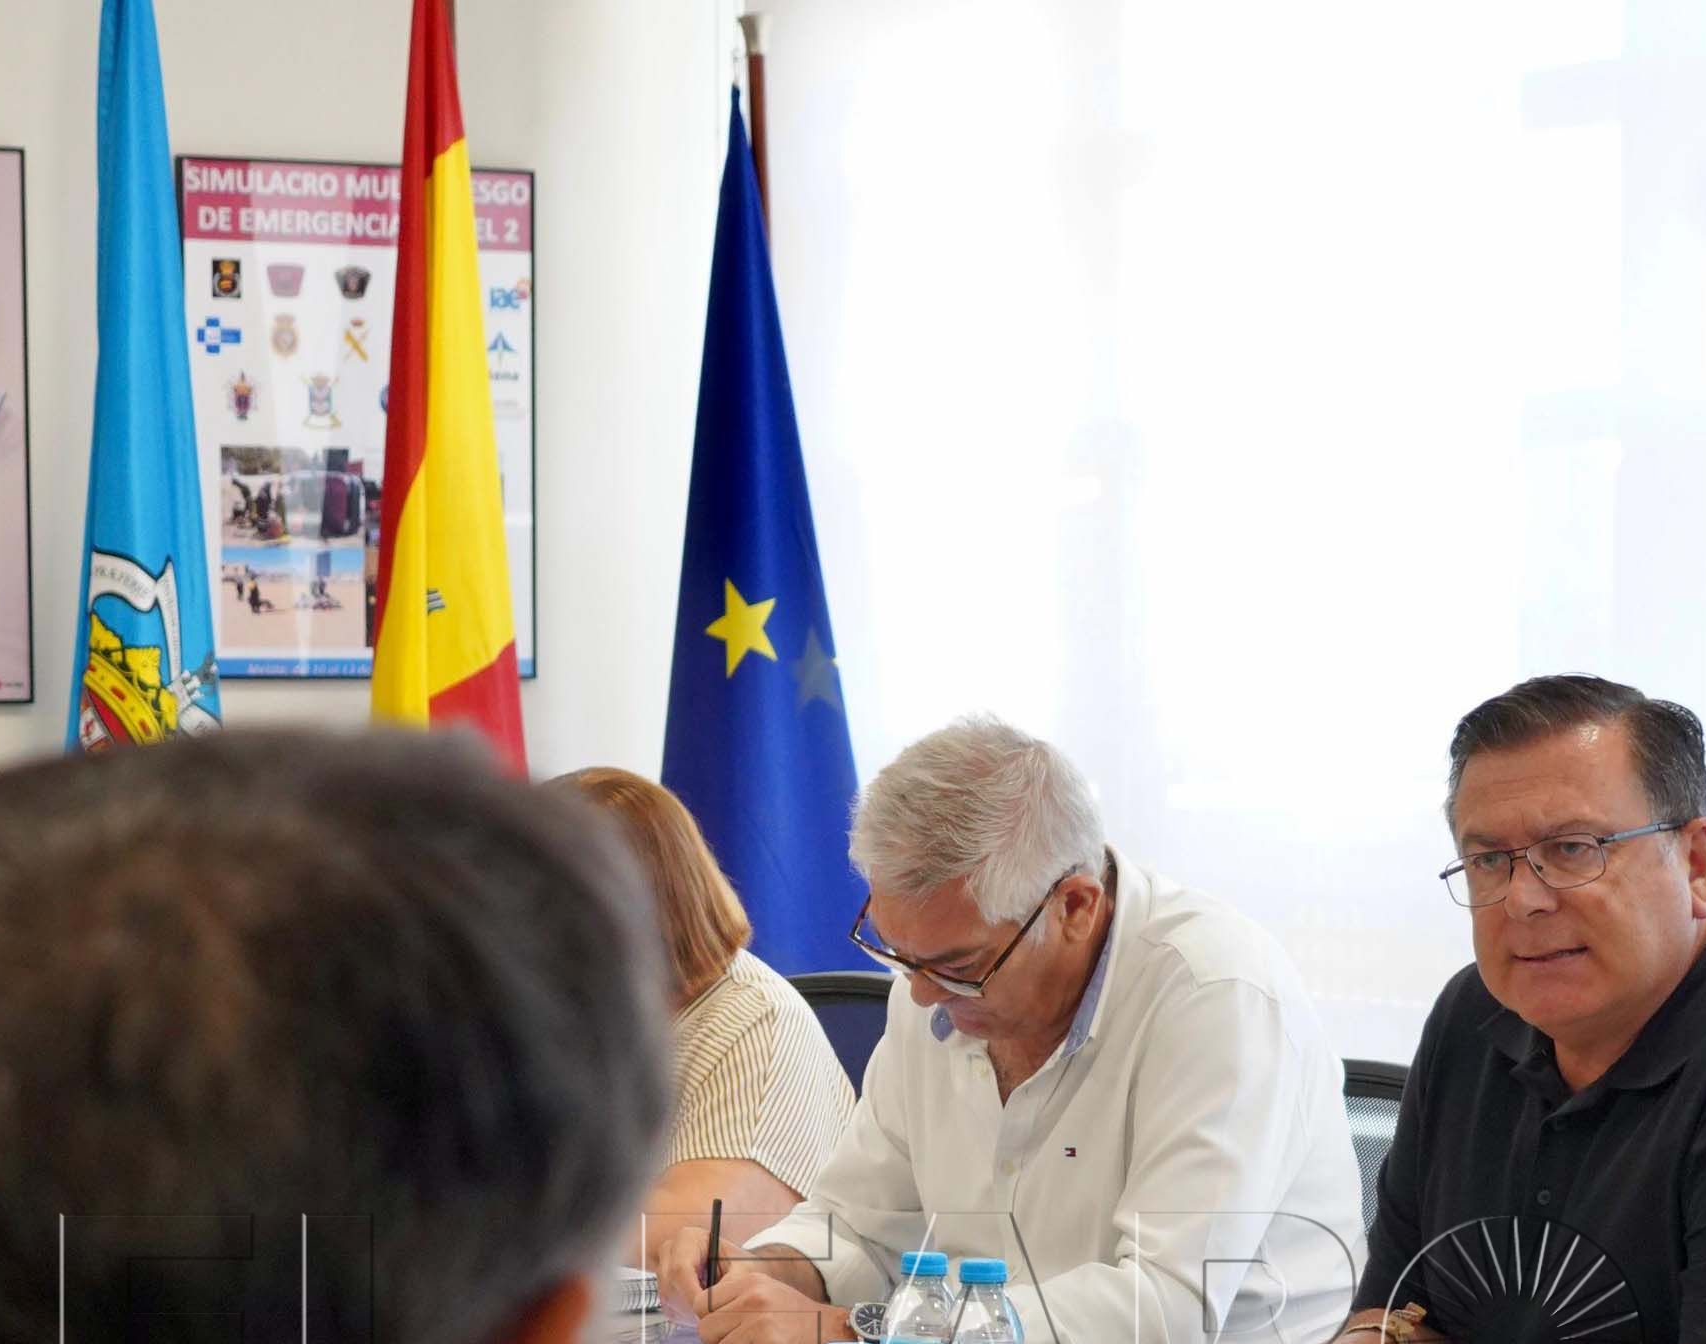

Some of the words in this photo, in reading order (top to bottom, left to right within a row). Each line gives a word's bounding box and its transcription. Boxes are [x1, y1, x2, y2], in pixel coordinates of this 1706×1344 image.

[185, 166, 339, 197] SIMULACRO
[198, 206, 232, 232] DE
[504, 218, 520, 244] 2
